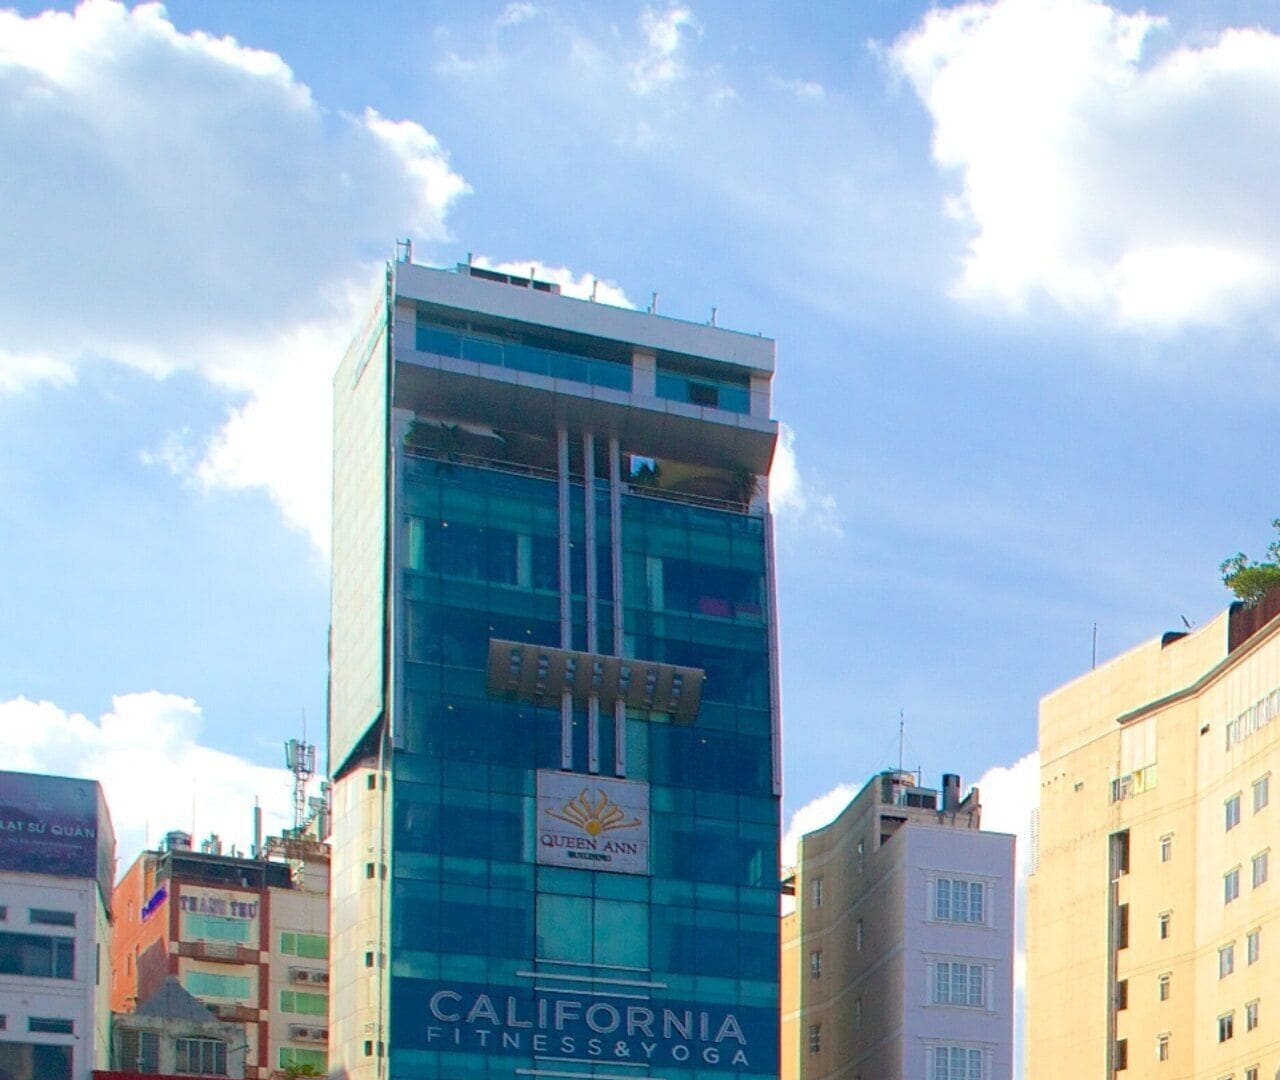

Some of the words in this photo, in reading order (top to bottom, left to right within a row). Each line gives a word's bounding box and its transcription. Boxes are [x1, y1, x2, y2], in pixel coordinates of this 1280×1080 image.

[541, 834, 597, 850] QUEEN
[603, 841, 638, 855] ANN
[429, 989, 747, 1046] CALIFORNIA
